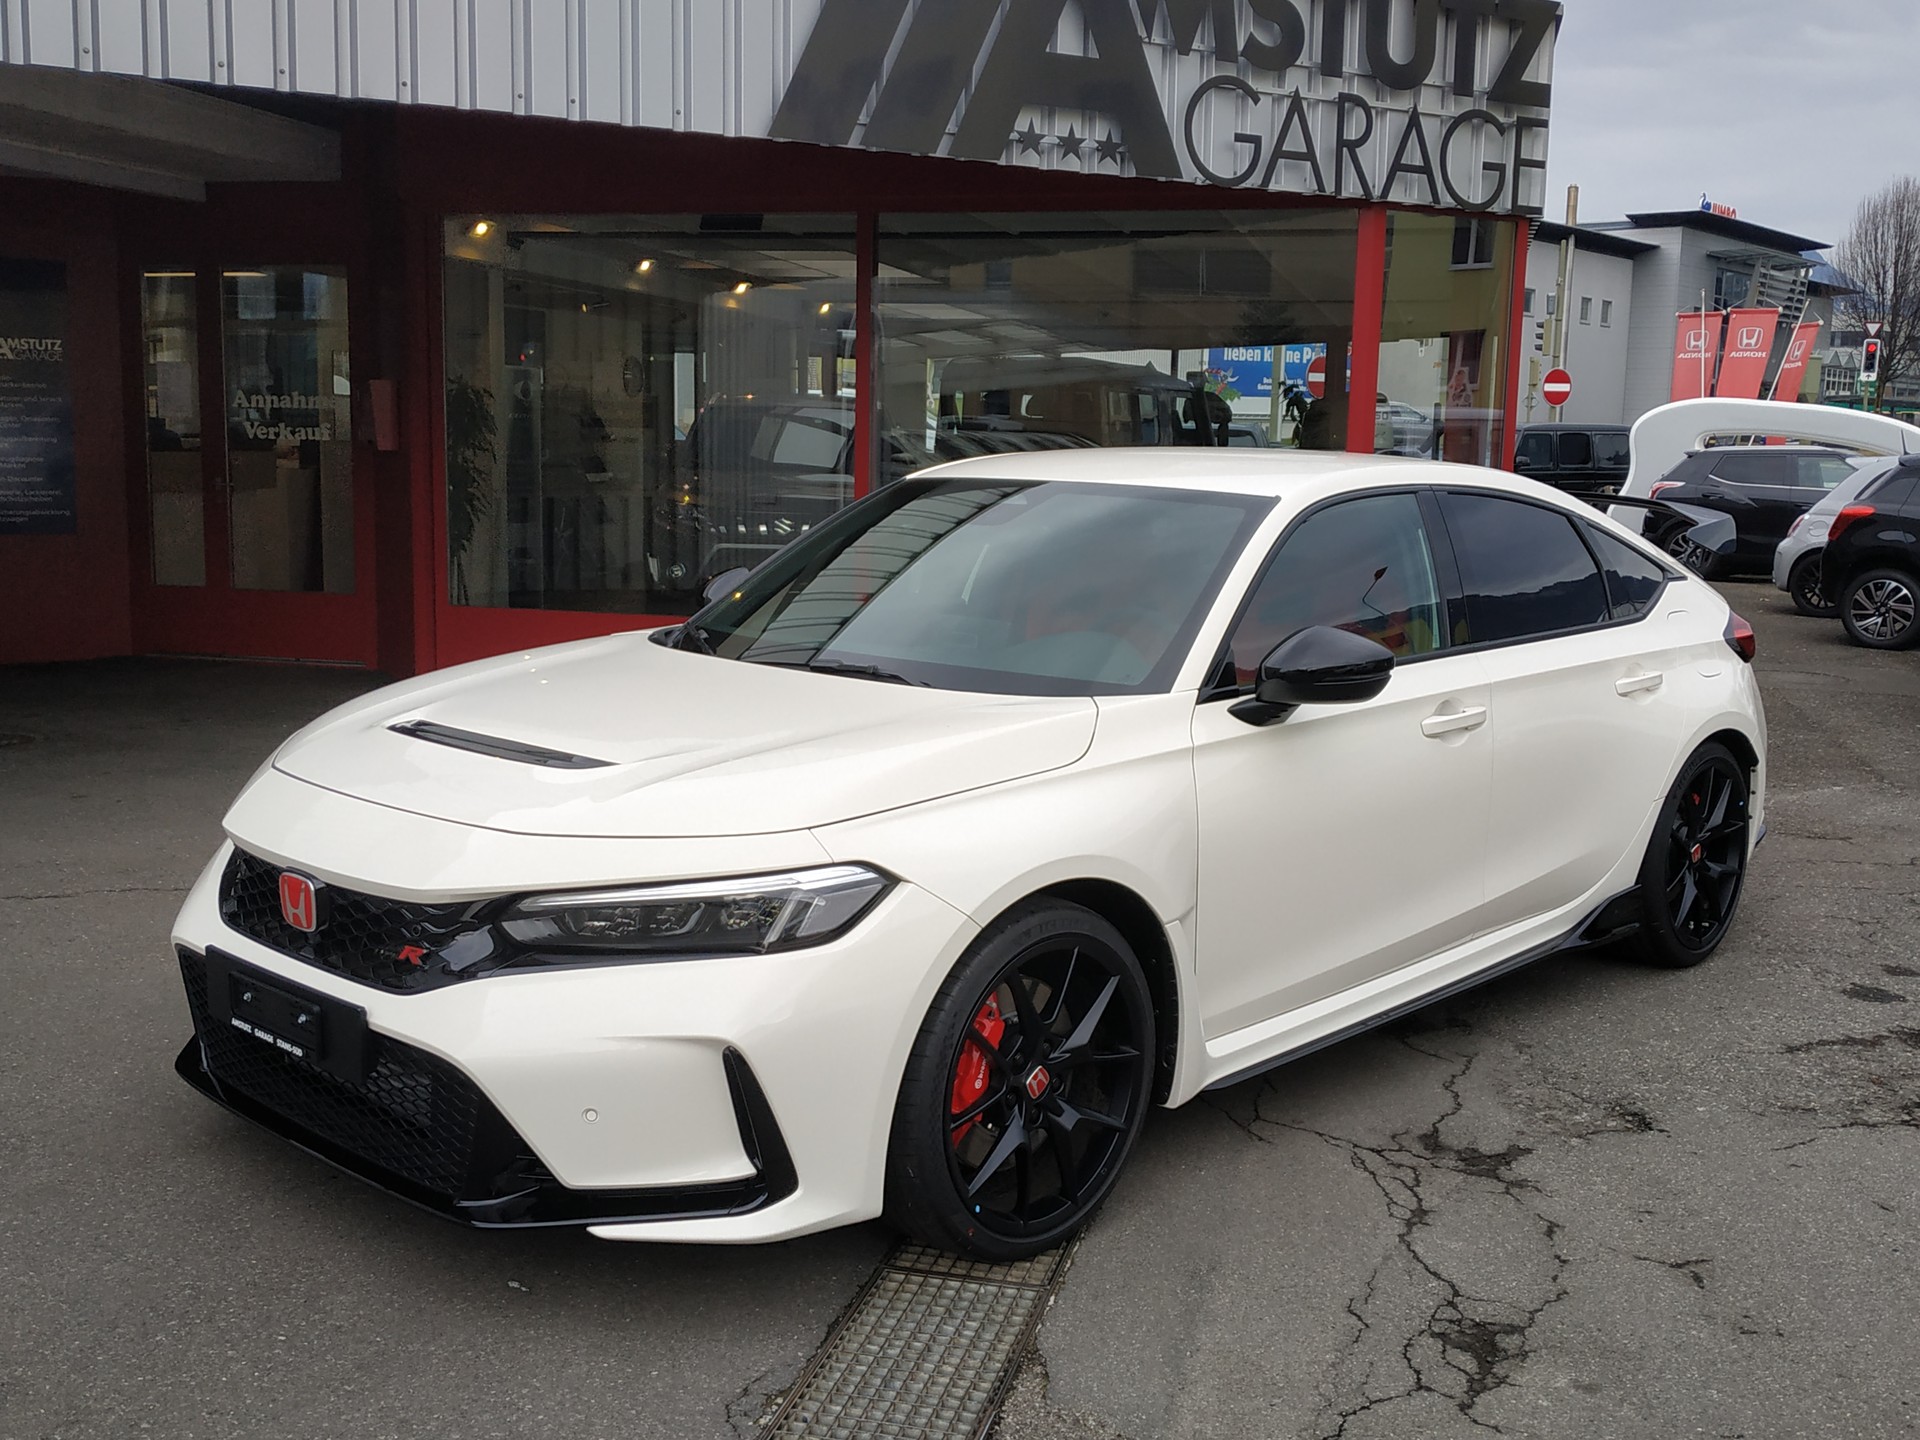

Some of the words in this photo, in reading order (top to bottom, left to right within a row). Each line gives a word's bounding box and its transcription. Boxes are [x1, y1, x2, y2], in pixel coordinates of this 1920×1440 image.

[1184, 74, 1549, 216] GARAGE
[13, 349, 63, 361] GARAGE
[243, 421, 332, 441] Verkauf
[231, 1017, 252, 1034] AMSTUTZ
[254, 1028, 274, 1044] GARAGE
